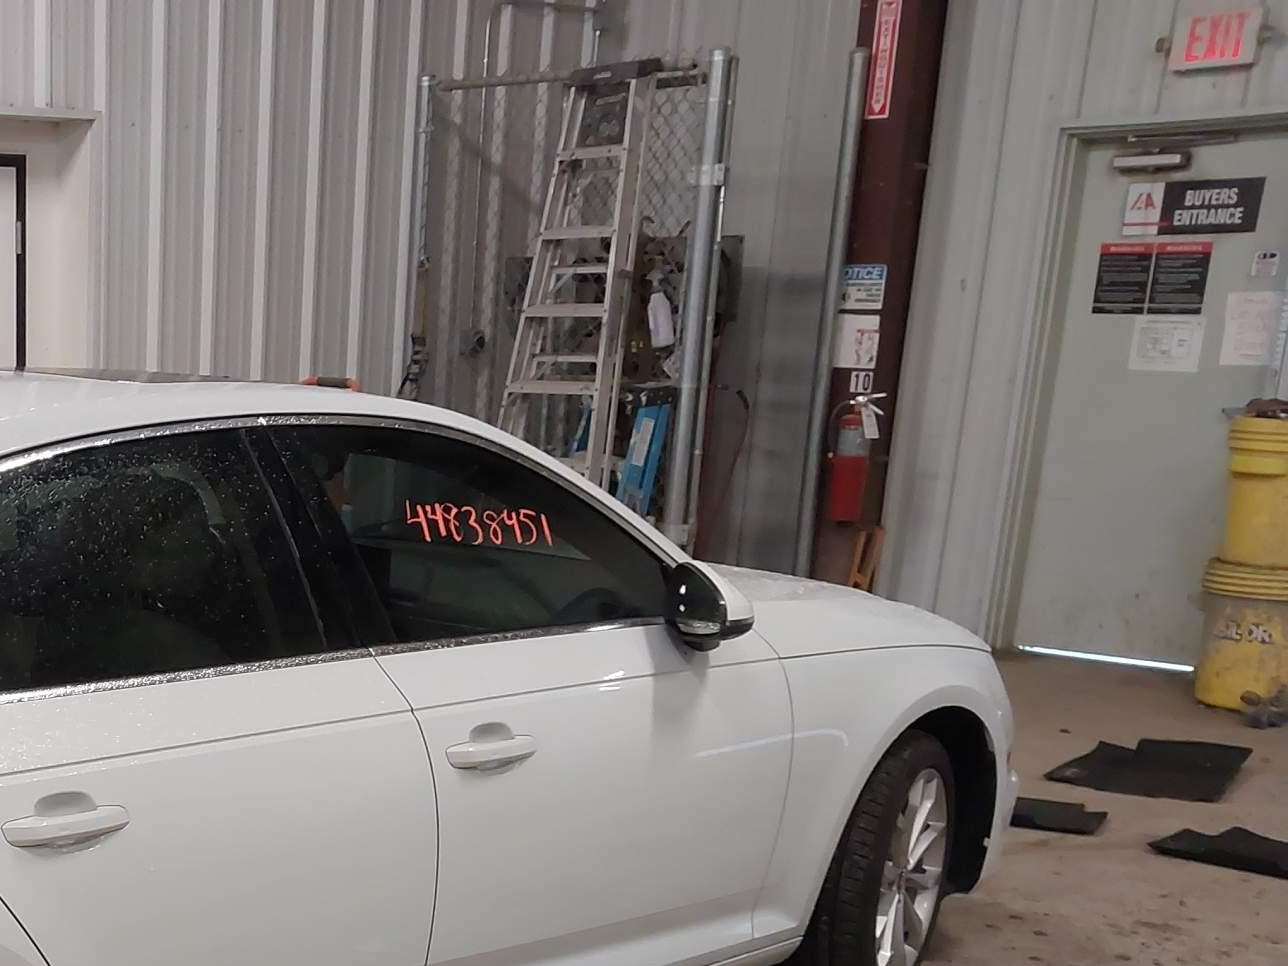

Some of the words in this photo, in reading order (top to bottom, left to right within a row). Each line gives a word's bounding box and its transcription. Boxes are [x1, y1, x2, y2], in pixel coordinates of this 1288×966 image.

[1184, 13, 1250, 61] EXIT
[1184, 188, 1239, 206] BUYERS
[1173, 208, 1244, 225] ENTRANCE
[842, 265, 884, 281] OTICE
[854, 374, 871, 391] 10
[405, 499, 552, 546] 44838451
